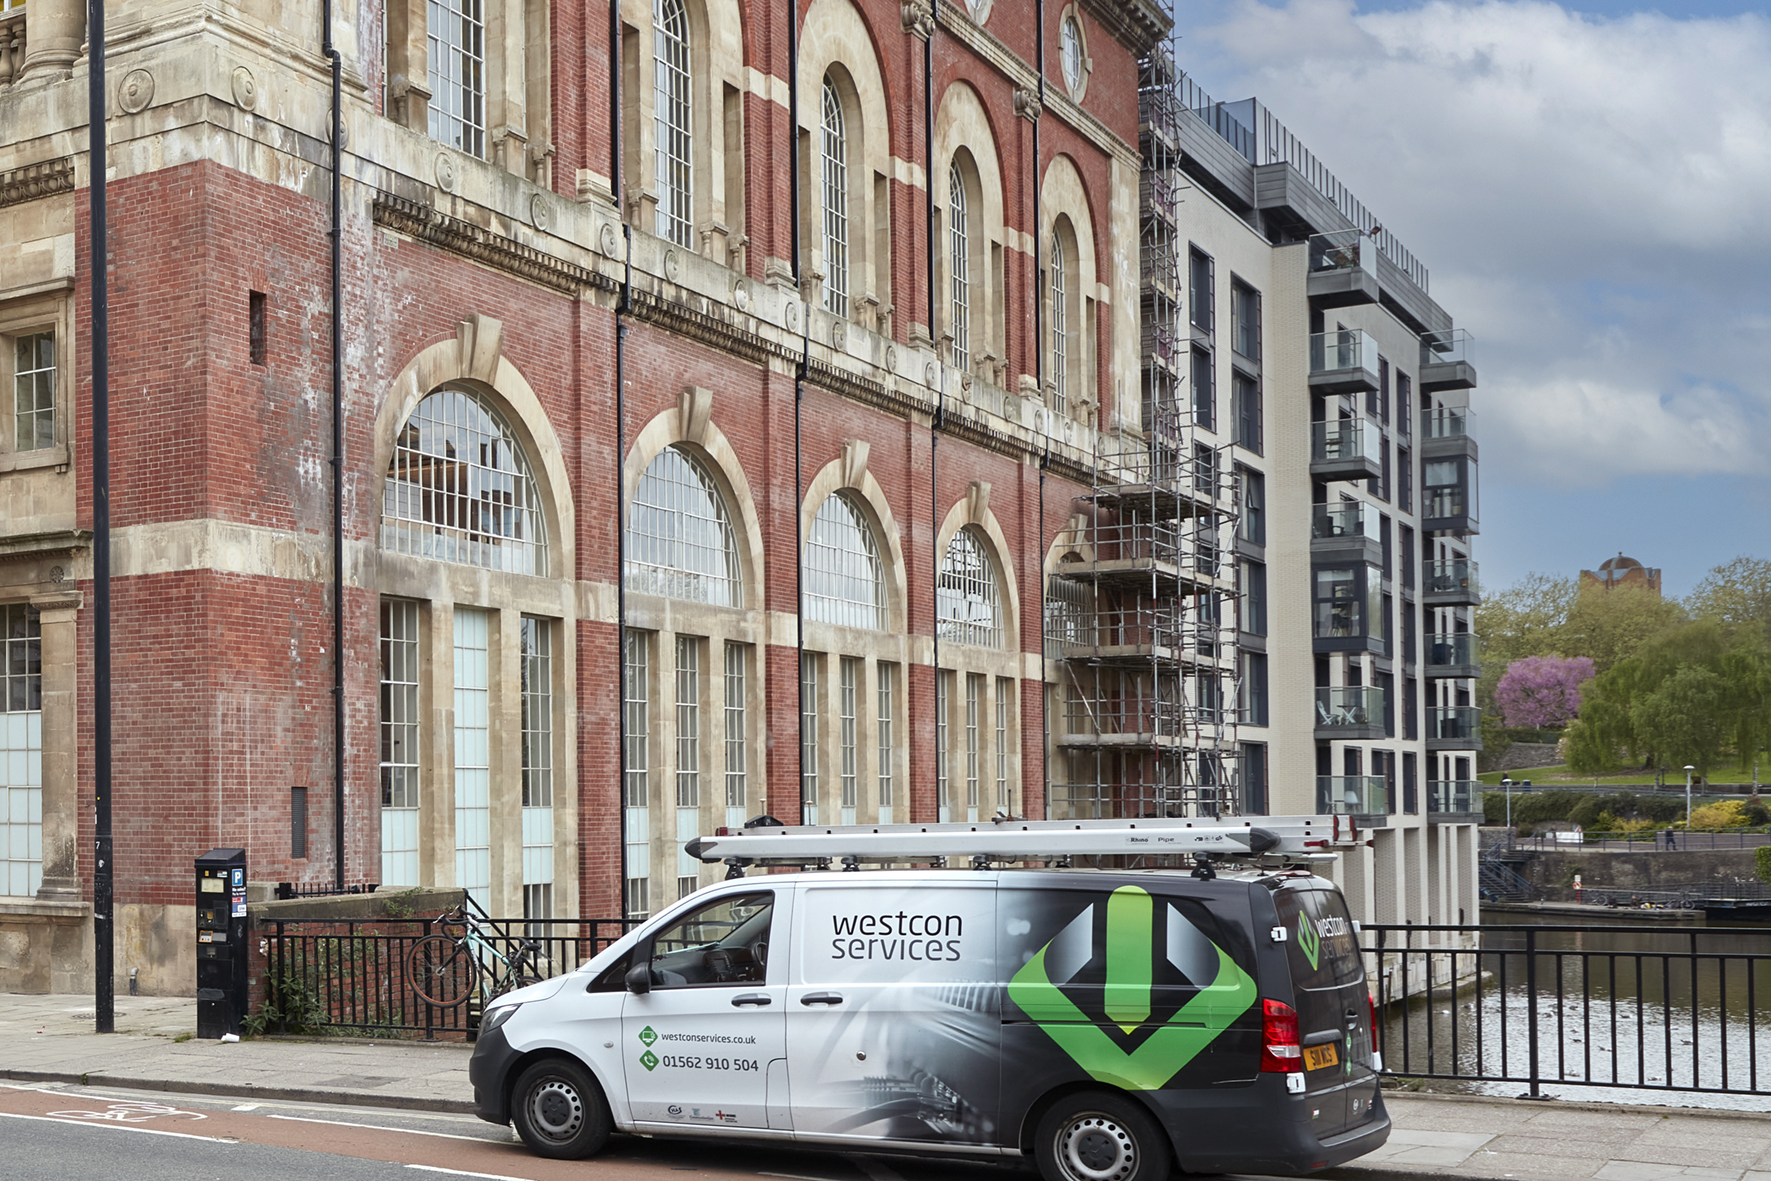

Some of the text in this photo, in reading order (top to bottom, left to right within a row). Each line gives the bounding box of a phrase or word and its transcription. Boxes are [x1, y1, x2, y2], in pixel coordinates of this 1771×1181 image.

[235, 872, 241, 883] P
[832, 911, 962, 936] westcon
[1314, 914, 1348, 938] westcon
[832, 938, 961, 961] services
[661, 1033, 756, 1044] westconservices.co.uk
[662, 1055, 759, 1071] 01562 910 504
